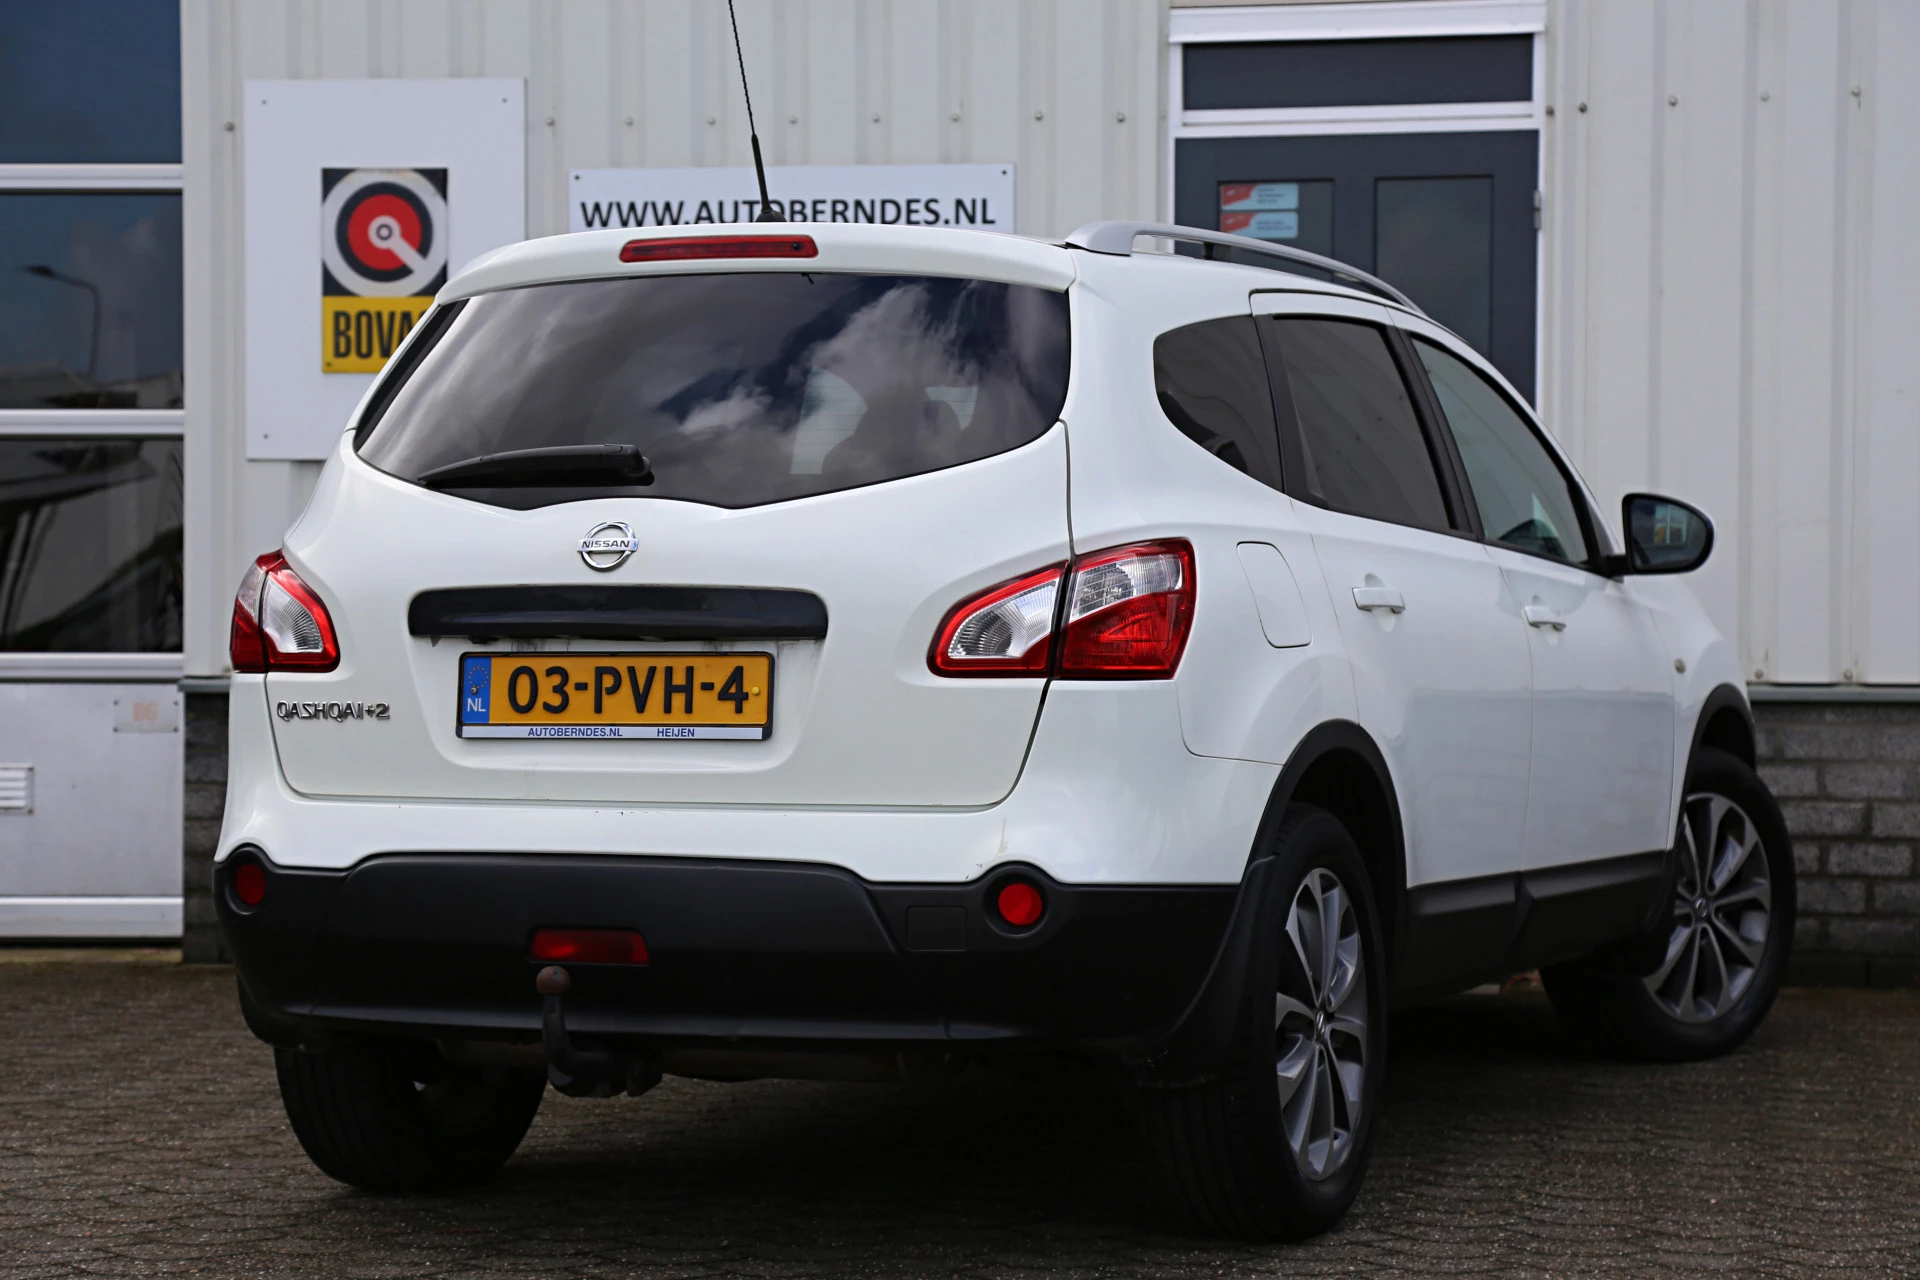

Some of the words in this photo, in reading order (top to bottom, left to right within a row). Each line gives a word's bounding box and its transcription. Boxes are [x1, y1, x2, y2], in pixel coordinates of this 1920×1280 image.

[333, 309, 425, 359] BOVA
[581, 540, 630, 549] NISSAN
[507, 665, 749, 714] 03-PVH-4
[276, 700, 390, 722] QASHQAI+2
[467, 697, 486, 712] NL
[527, 727, 623, 738] AUTOBERNDES.NL
[656, 728, 695, 738] HEIJEN
